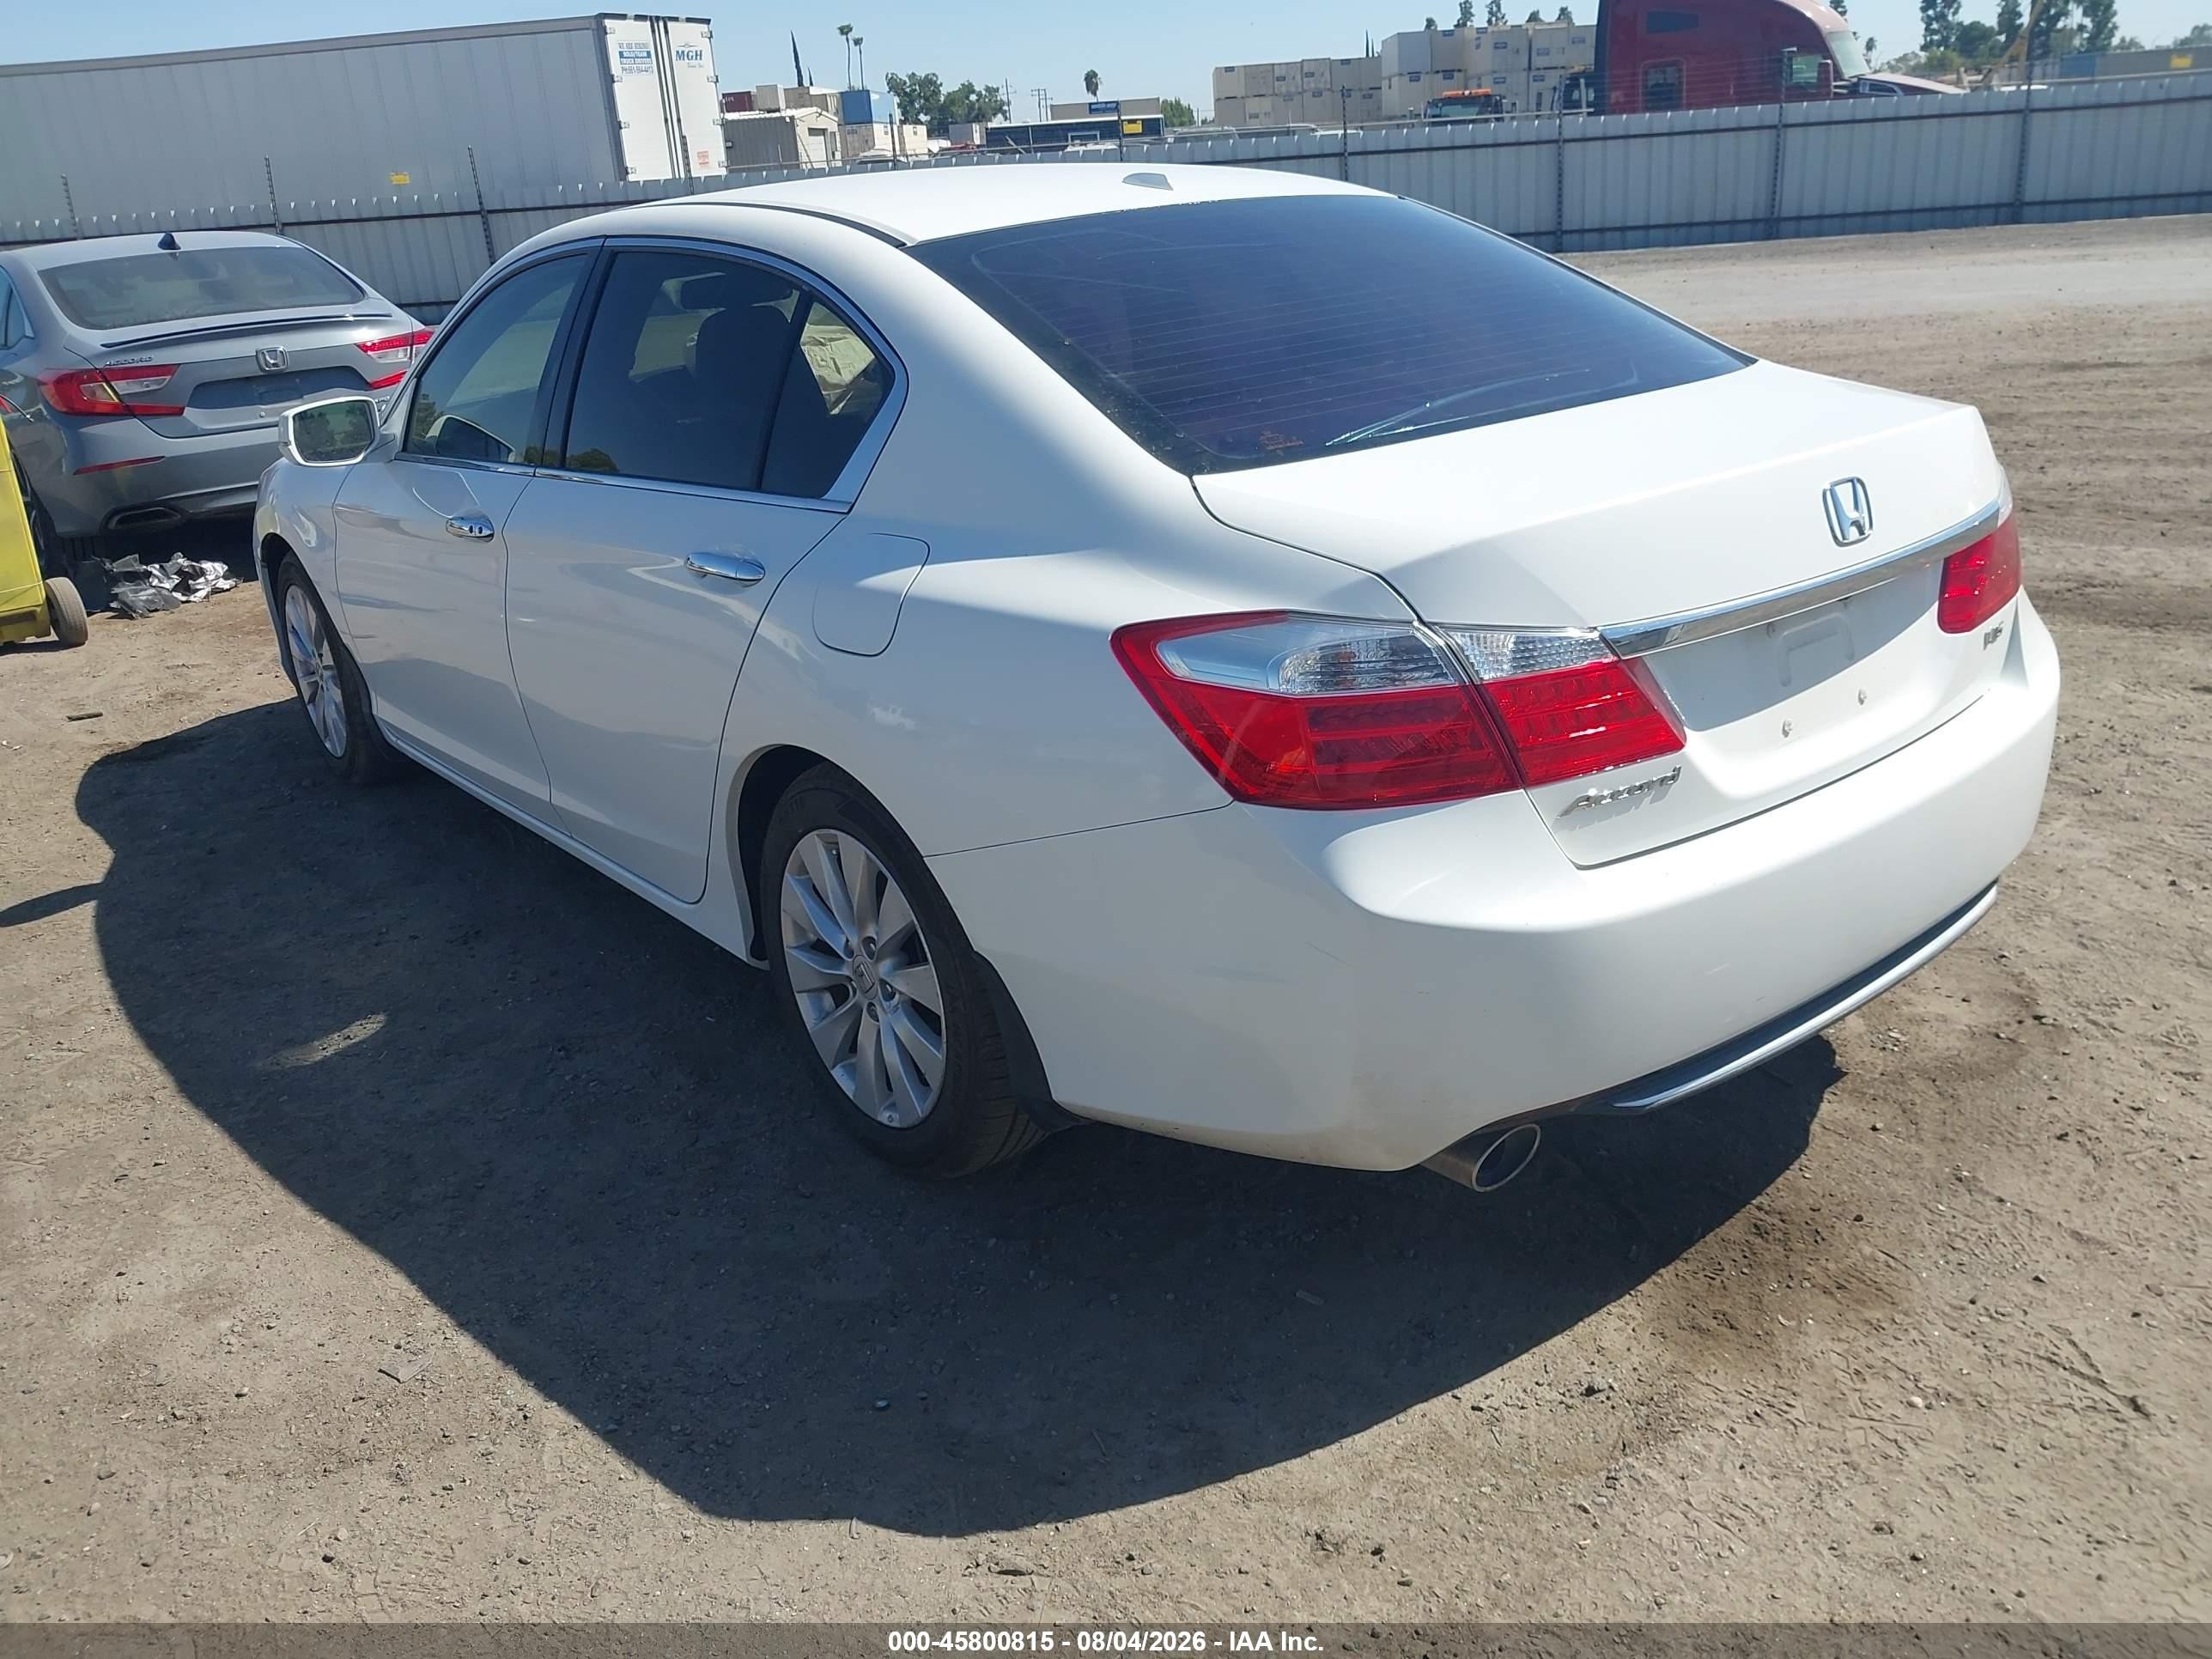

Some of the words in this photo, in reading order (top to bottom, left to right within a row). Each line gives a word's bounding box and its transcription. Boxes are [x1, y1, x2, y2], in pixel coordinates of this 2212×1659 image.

[675, 49, 703, 61] MGH
[104, 356, 154, 367] ACCORD
[1555, 764, 1682, 819] Accord
